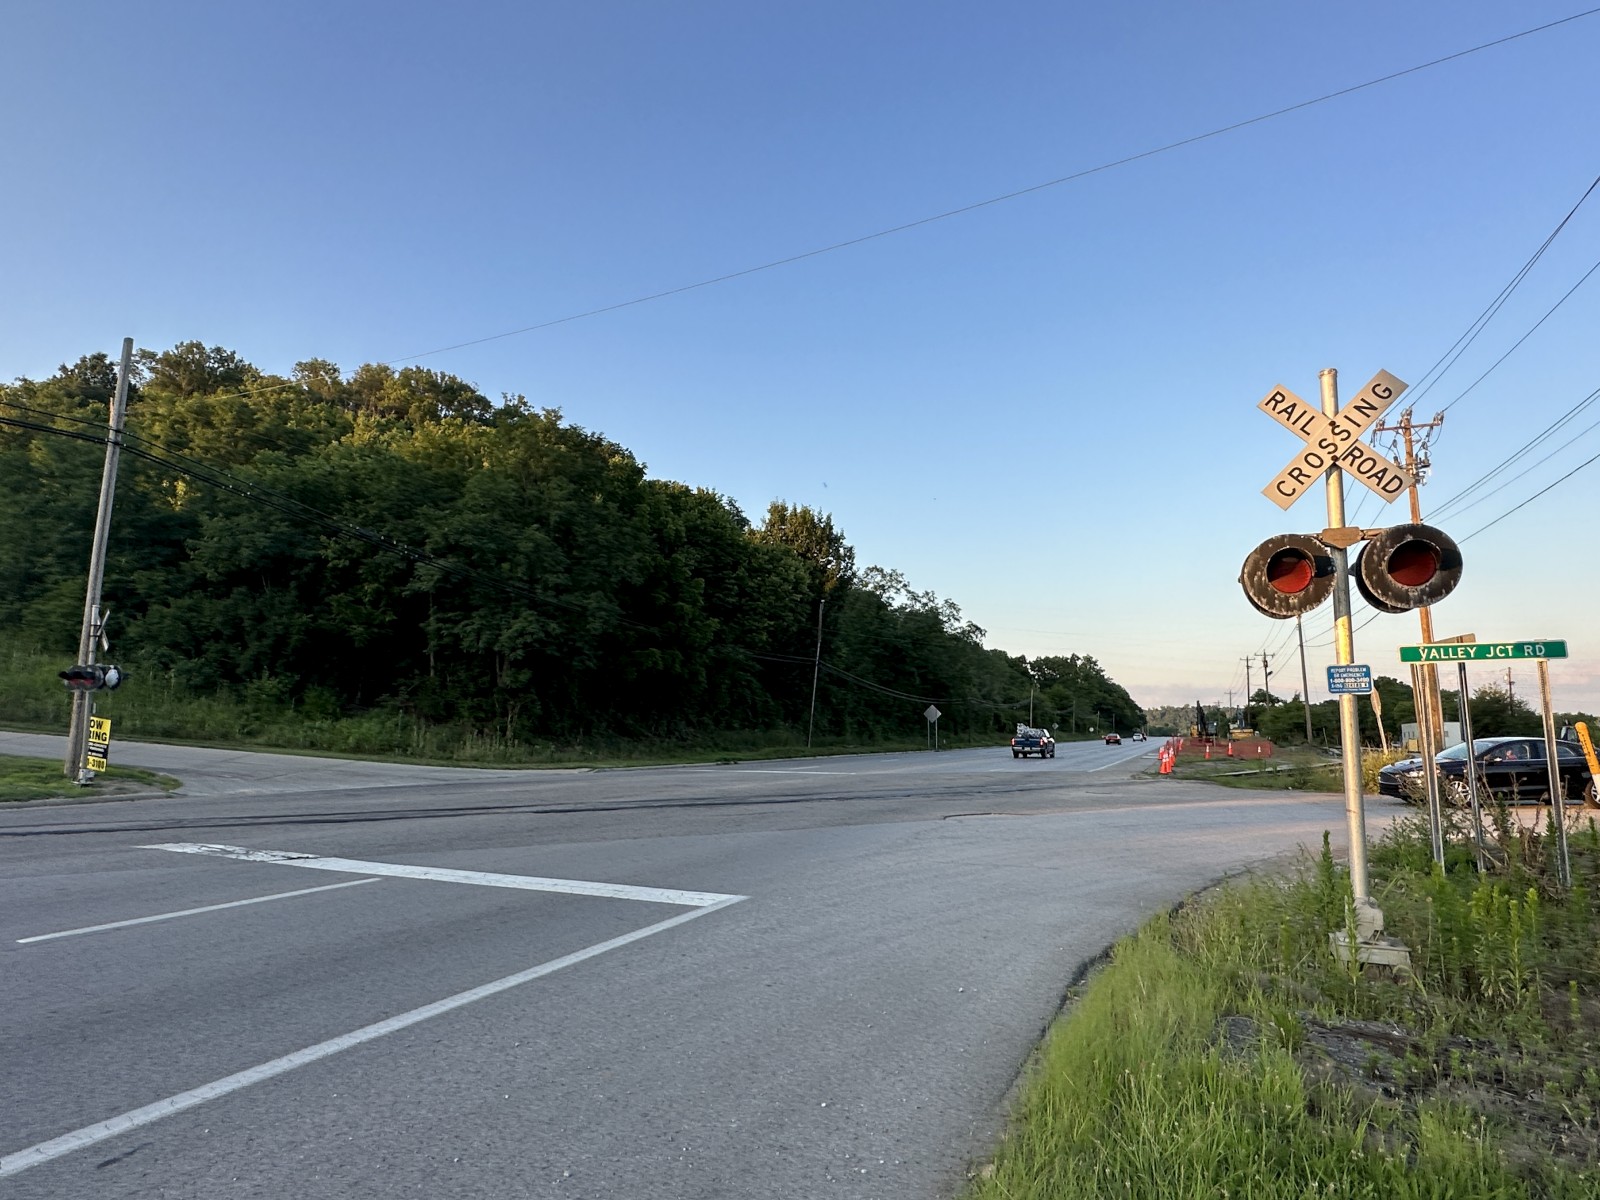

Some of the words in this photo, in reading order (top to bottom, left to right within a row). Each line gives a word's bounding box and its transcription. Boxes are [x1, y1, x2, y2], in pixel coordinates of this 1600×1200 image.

[1264, 390, 1316, 437] RAIL
[1341, 446, 1404, 494] ROAD
[1276, 383, 1393, 497] CROSSING
[1419, 646, 1477, 660] VALLEY
[1486, 645, 1514, 657] JCT
[1524, 644, 1546, 656] RD
[89, 719, 103, 730] OW
[89, 730, 107, 742] ING
